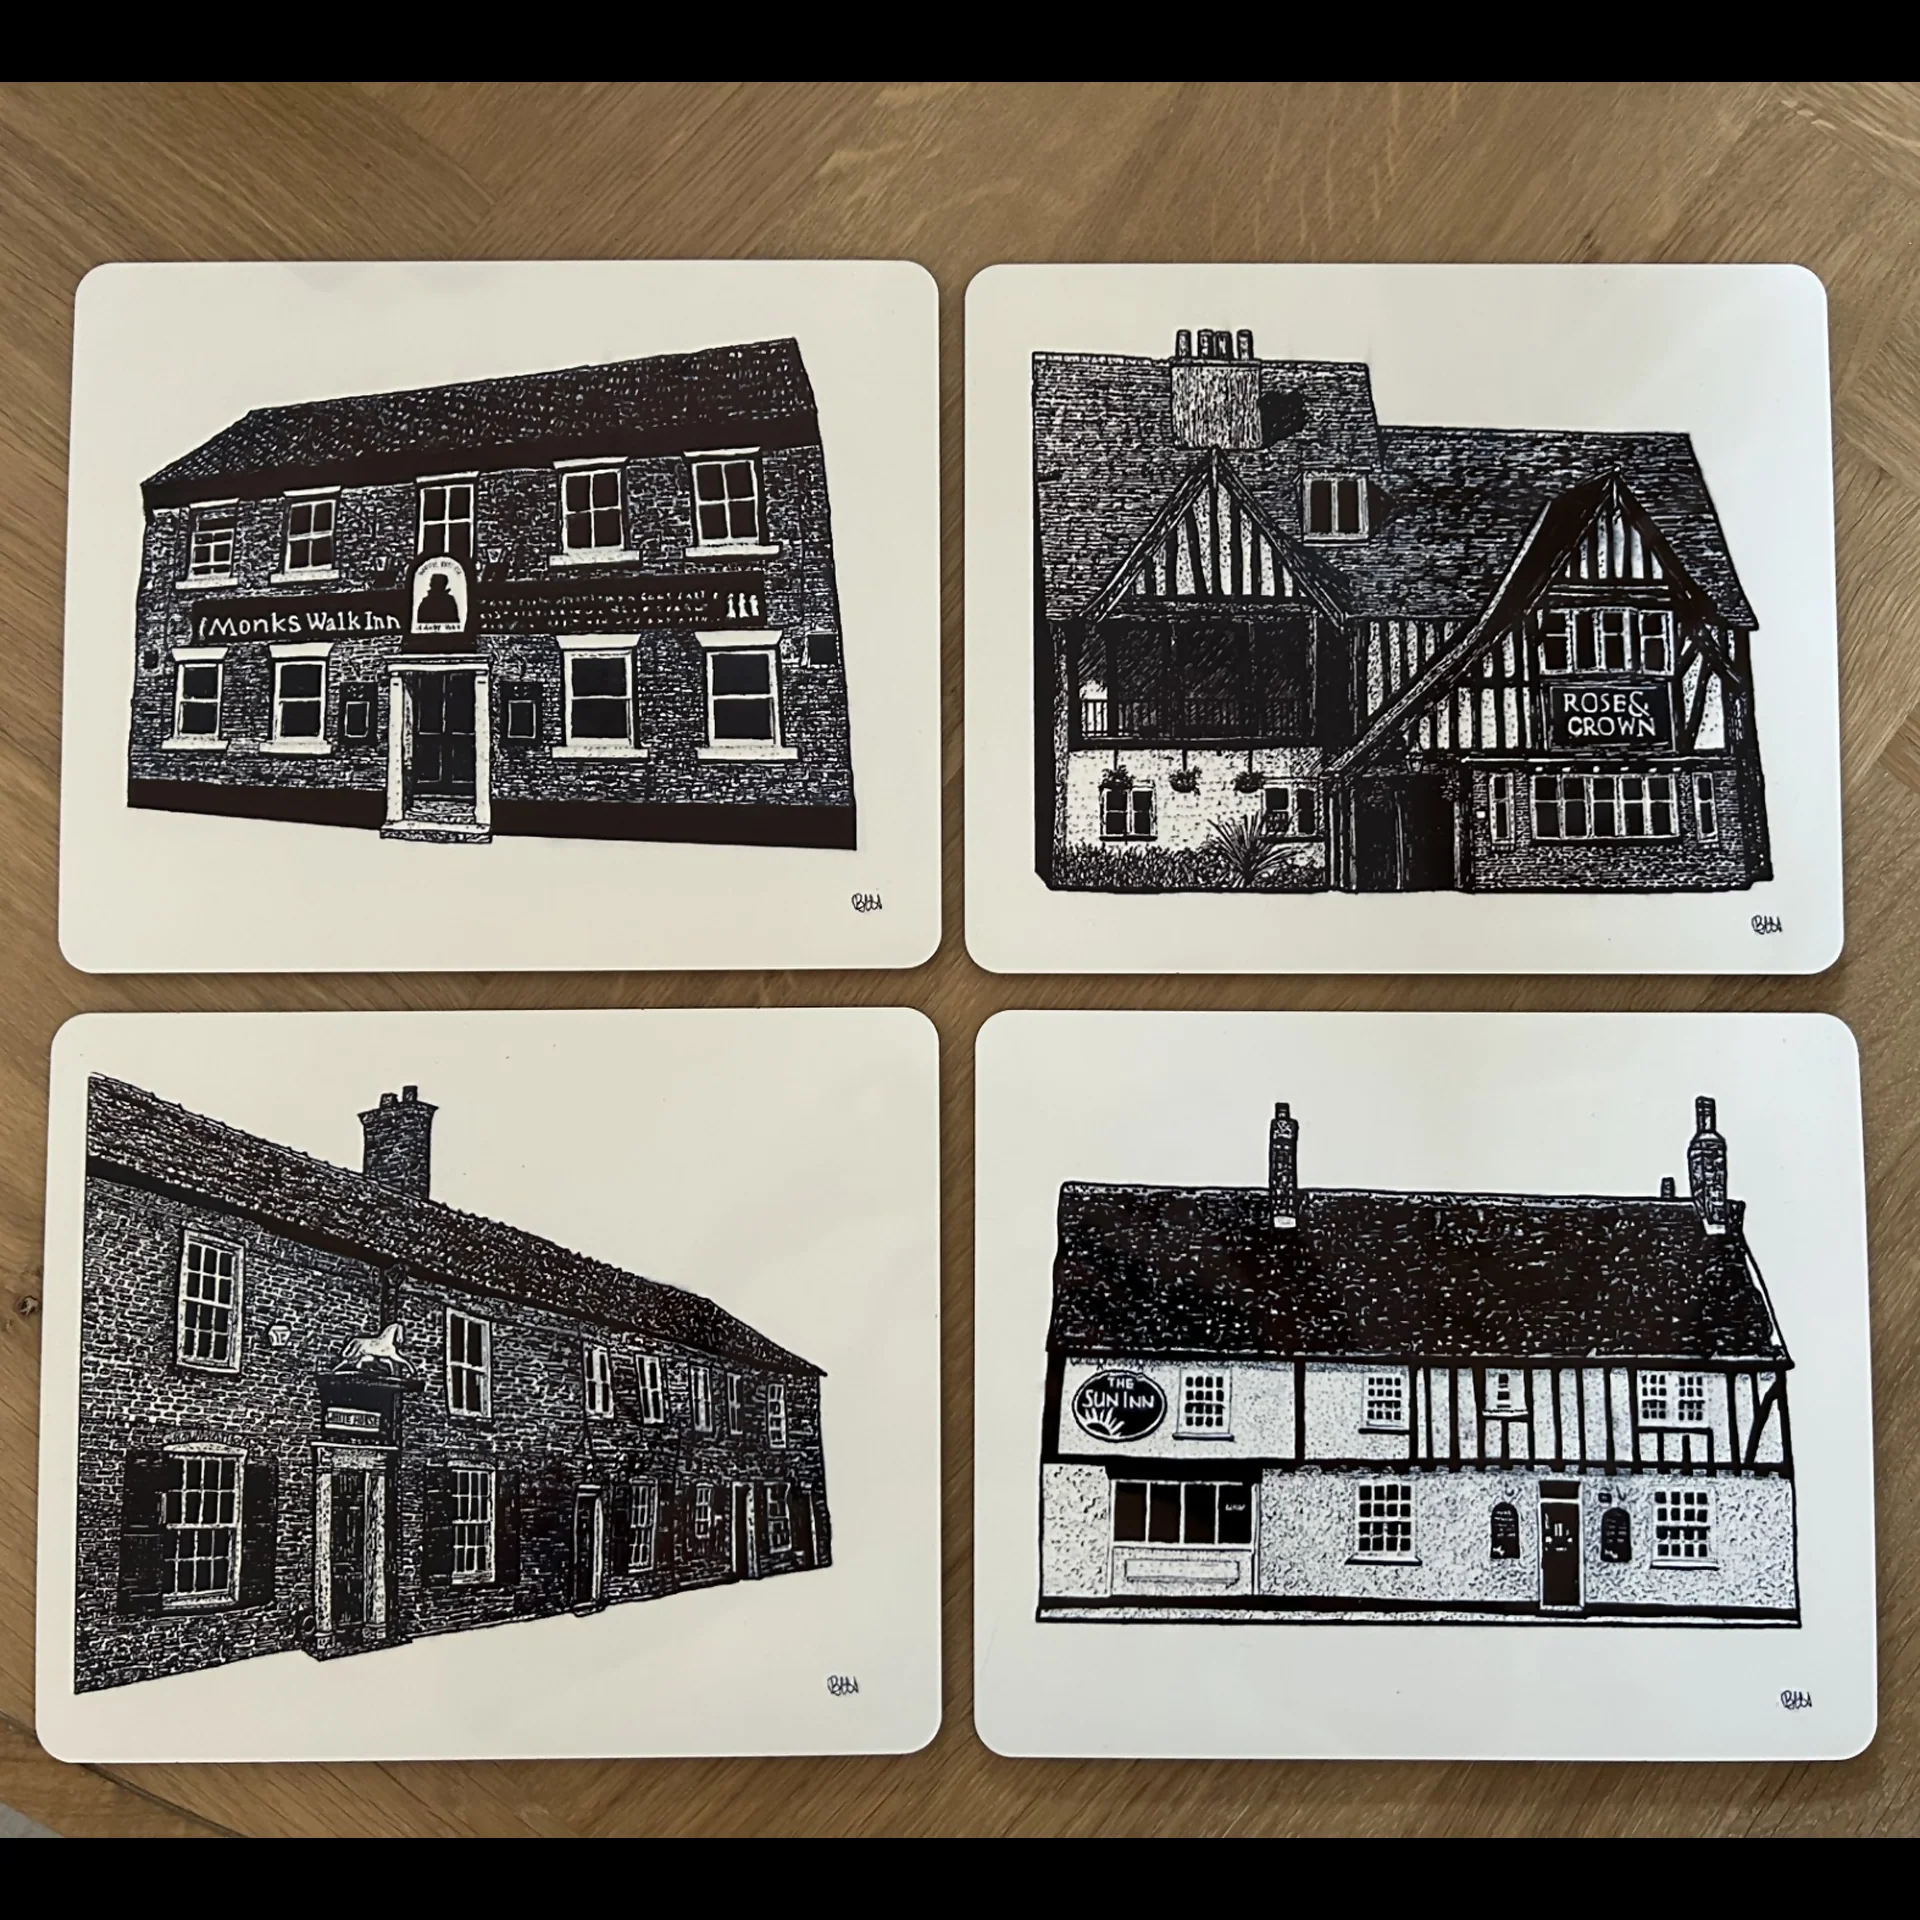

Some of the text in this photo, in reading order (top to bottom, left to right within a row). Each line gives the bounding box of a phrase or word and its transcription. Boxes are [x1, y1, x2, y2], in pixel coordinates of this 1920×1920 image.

[306, 611, 361, 631] Walk
[364, 611, 401, 630] Inn
[1568, 716, 1656, 737] CROWN
[1107, 1378, 1134, 1389] THE
[1082, 1389, 1155, 1409] SUN INN
